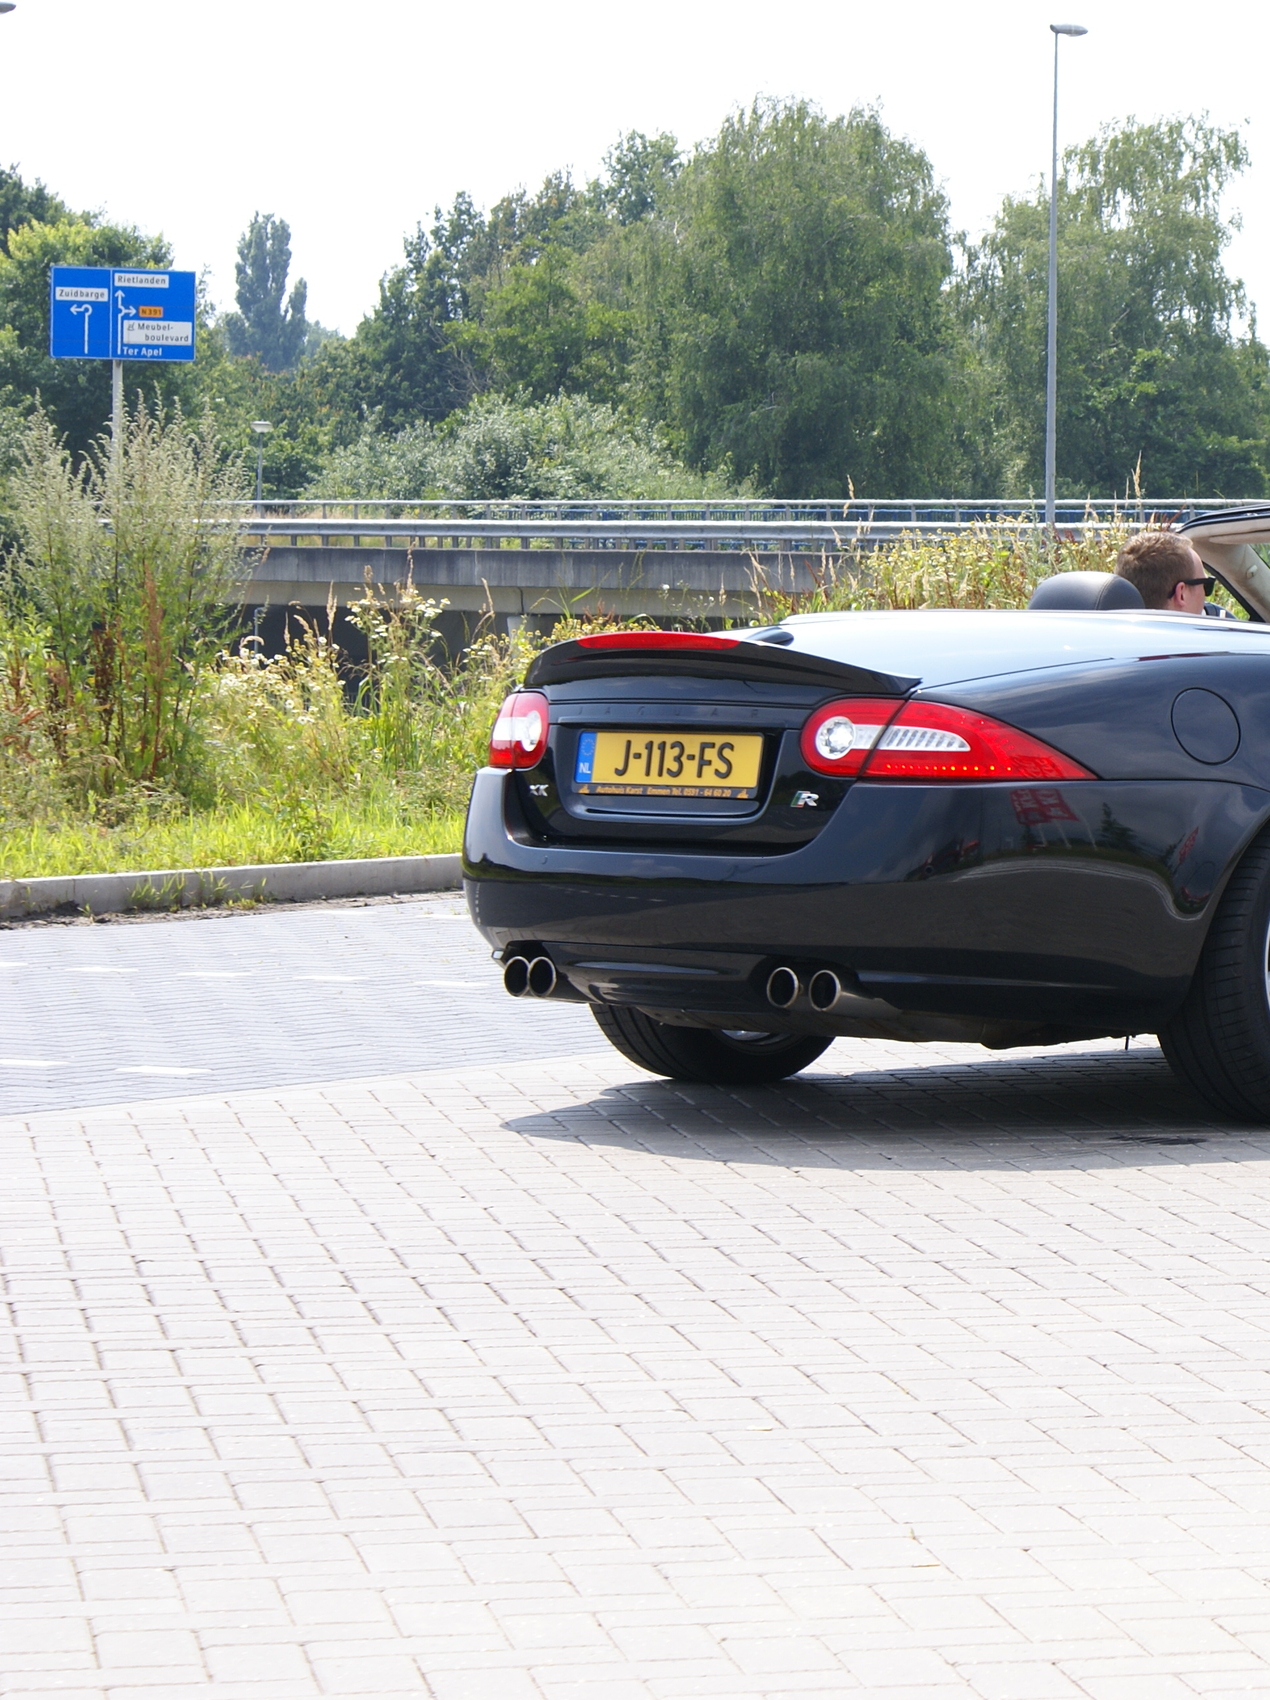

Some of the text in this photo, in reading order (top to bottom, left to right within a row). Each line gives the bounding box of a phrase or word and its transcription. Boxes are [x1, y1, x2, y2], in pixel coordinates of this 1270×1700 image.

[117, 275, 166, 285] Rietlanden
[58, 289, 105, 299] Zuidbarge
[137, 323, 174, 331] Meubel-
[144, 334, 189, 342] boulevard
[123, 347, 162, 358] Ter Apel
[614, 739, 735, 779] J-113-FS
[579, 762, 592, 774] NL
